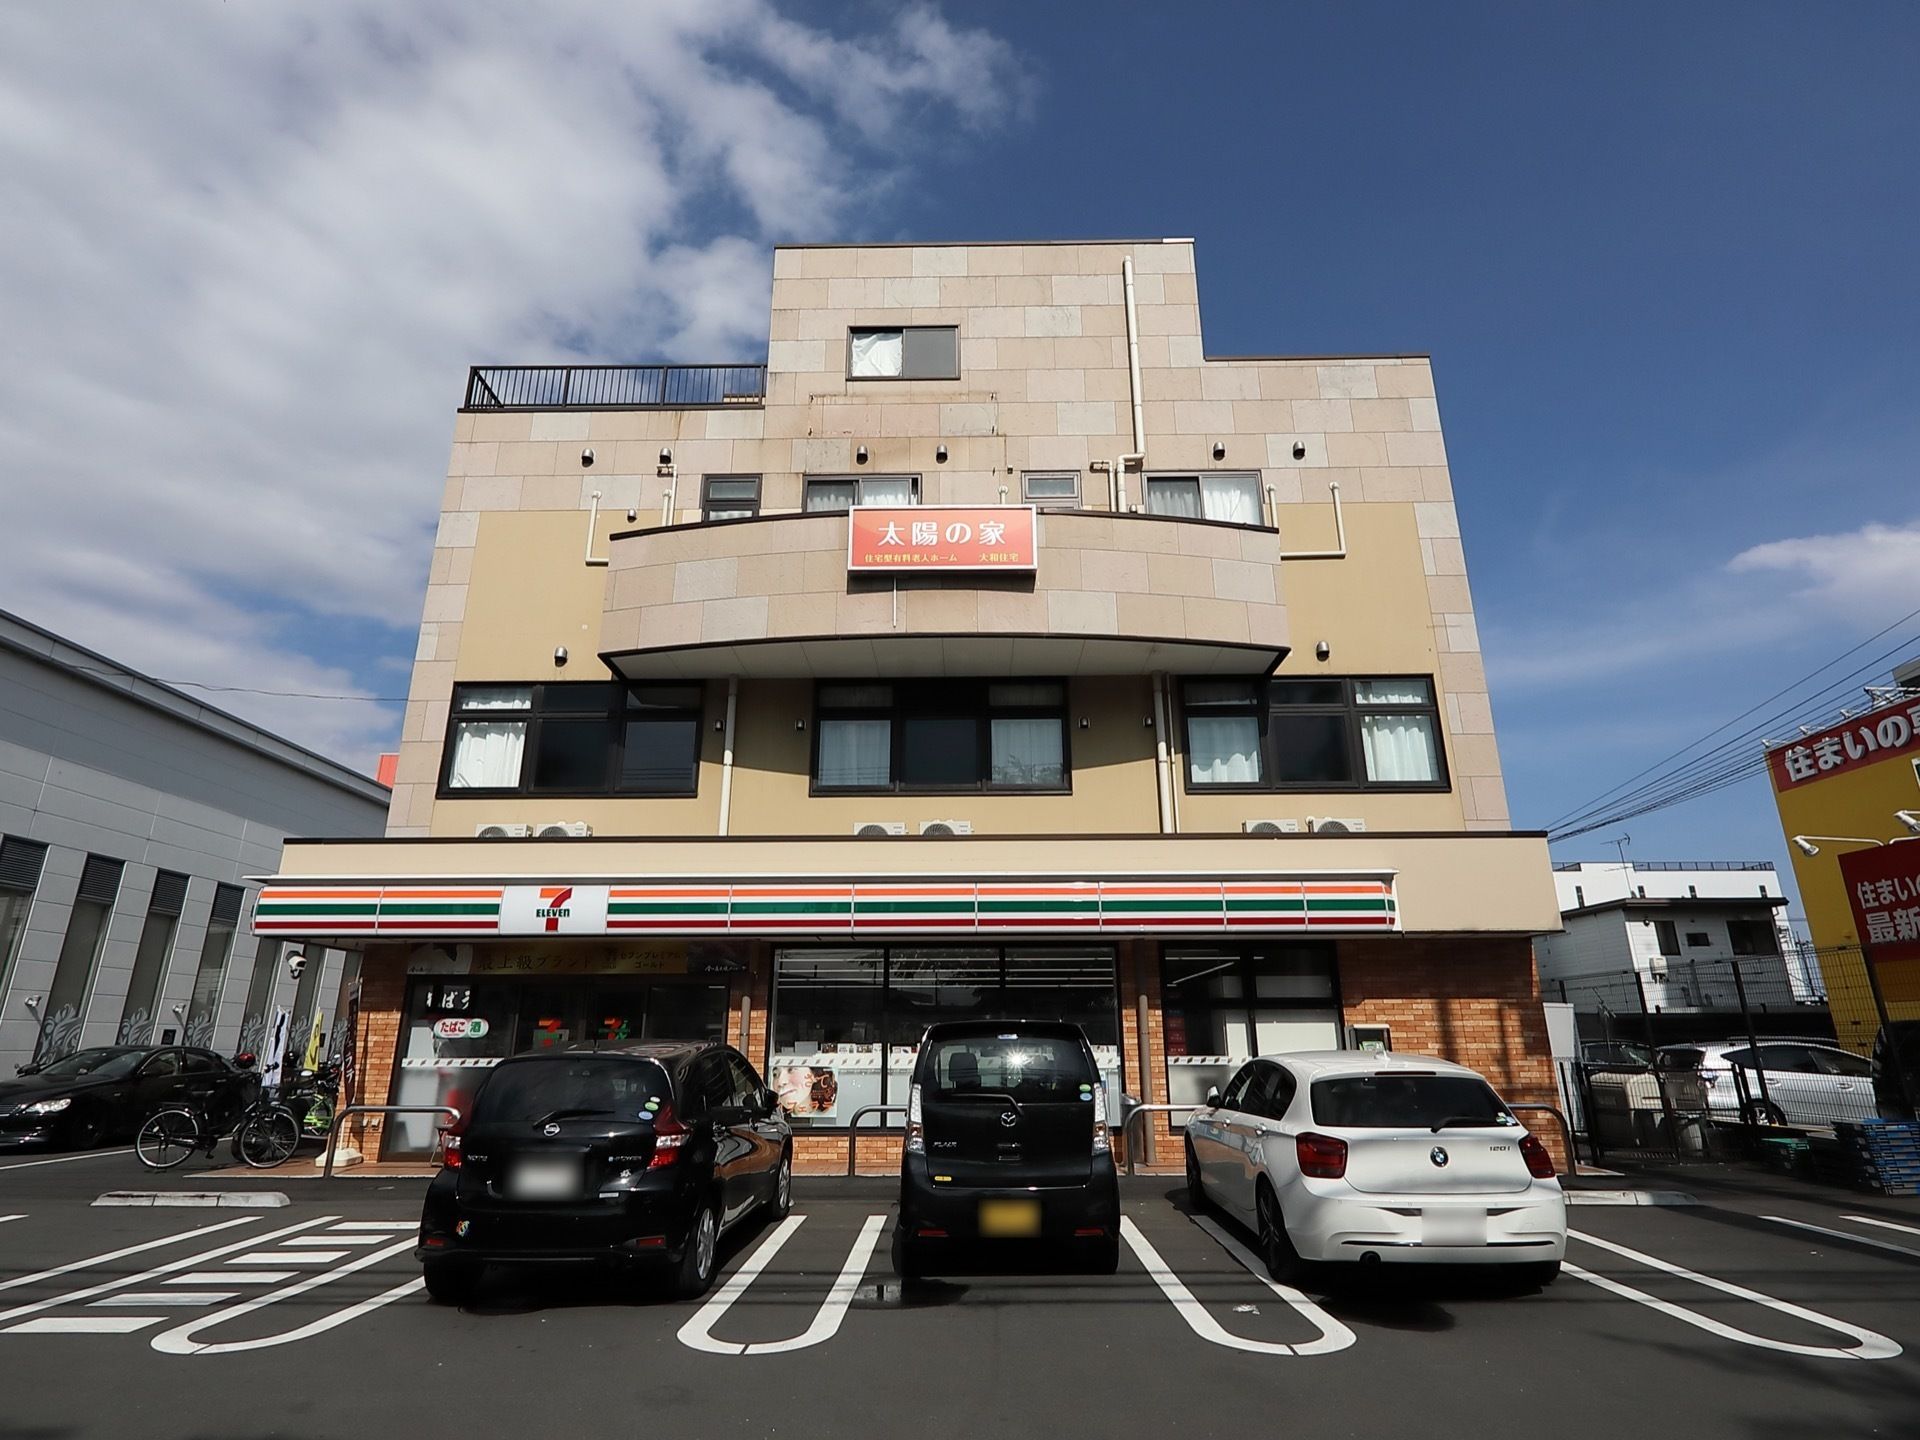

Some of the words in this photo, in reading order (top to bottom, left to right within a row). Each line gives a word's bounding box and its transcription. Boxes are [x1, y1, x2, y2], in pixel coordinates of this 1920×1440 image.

[877, 520, 1006, 547] 太陽の家
[864, 553, 958, 563] 住宅型有料老人ホーム
[1857, 873, 1920, 909] 住まい
[440, 1021, 466, 1033] たばこ
